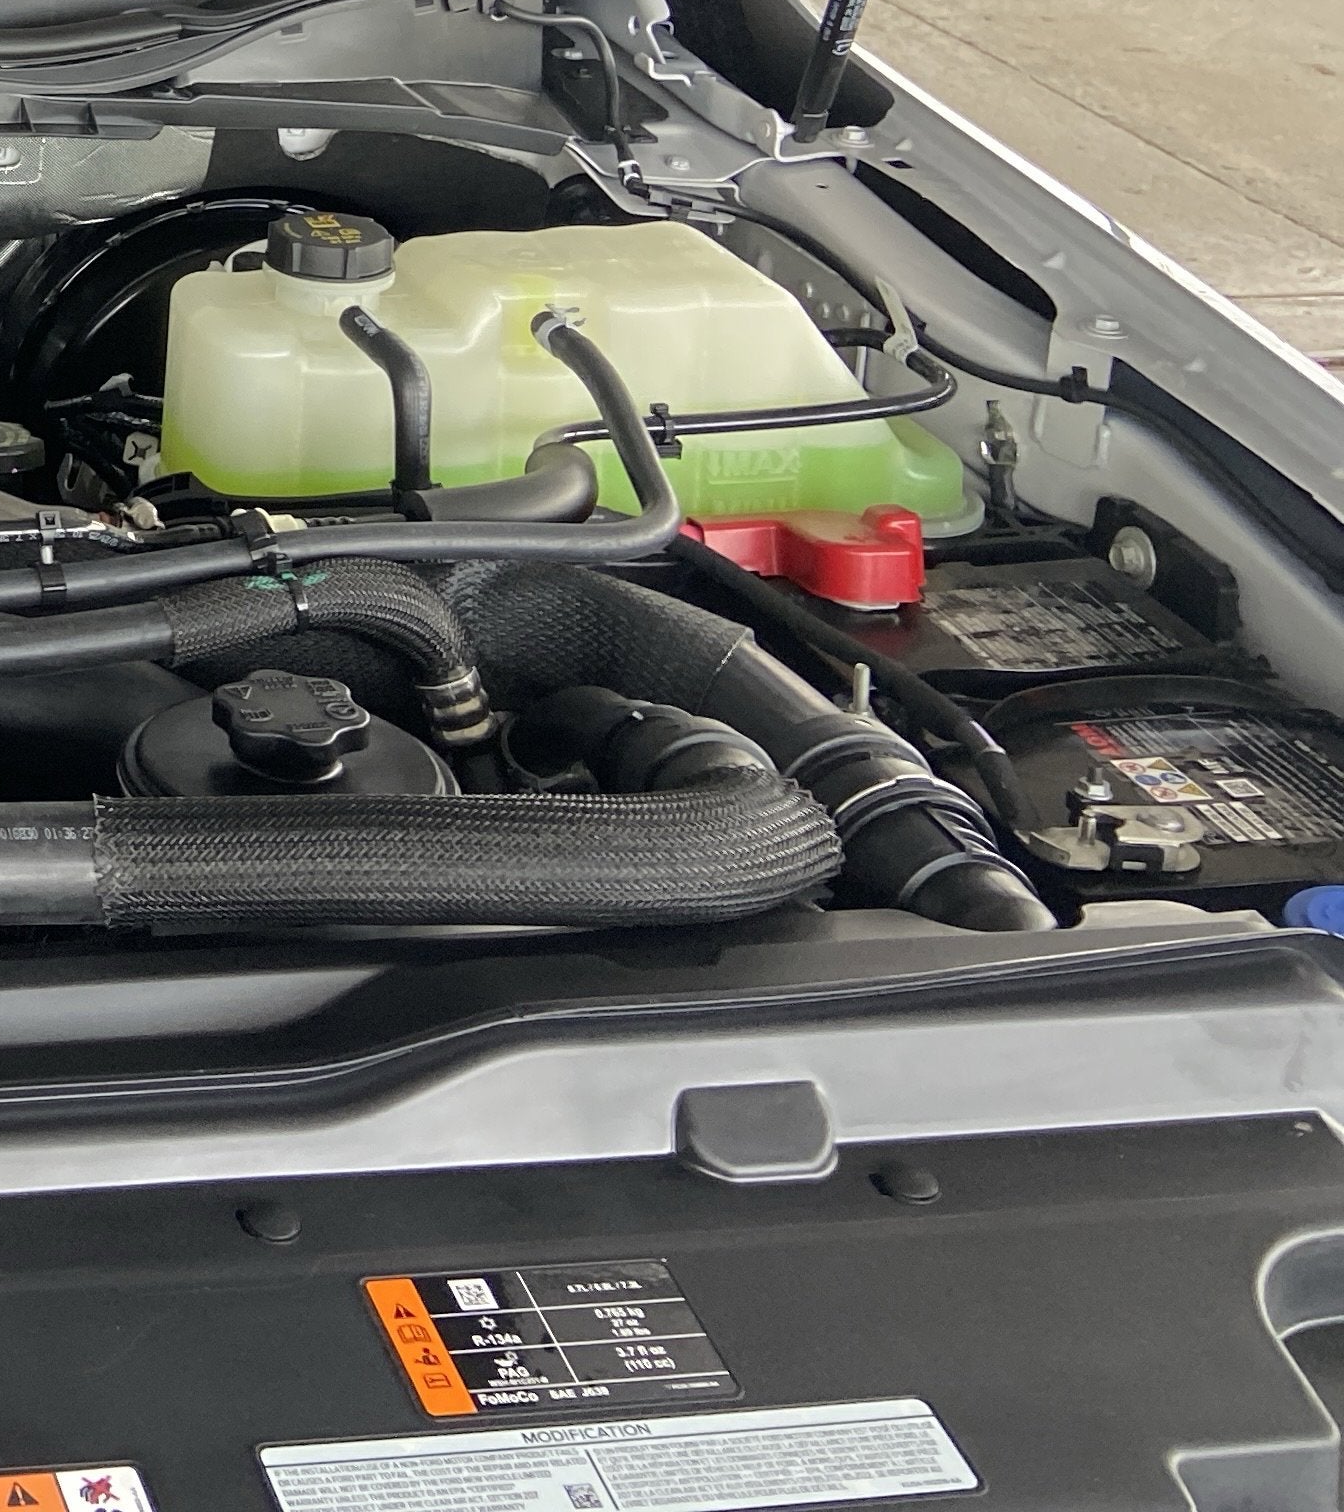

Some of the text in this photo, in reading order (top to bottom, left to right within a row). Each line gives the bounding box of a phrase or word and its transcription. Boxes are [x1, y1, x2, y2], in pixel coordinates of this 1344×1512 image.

[471, 1332, 523, 1347] R-134a
[478, 1390, 540, 1406] FoMoCo
[521, 1423, 652, 1444] MODIFICATION
